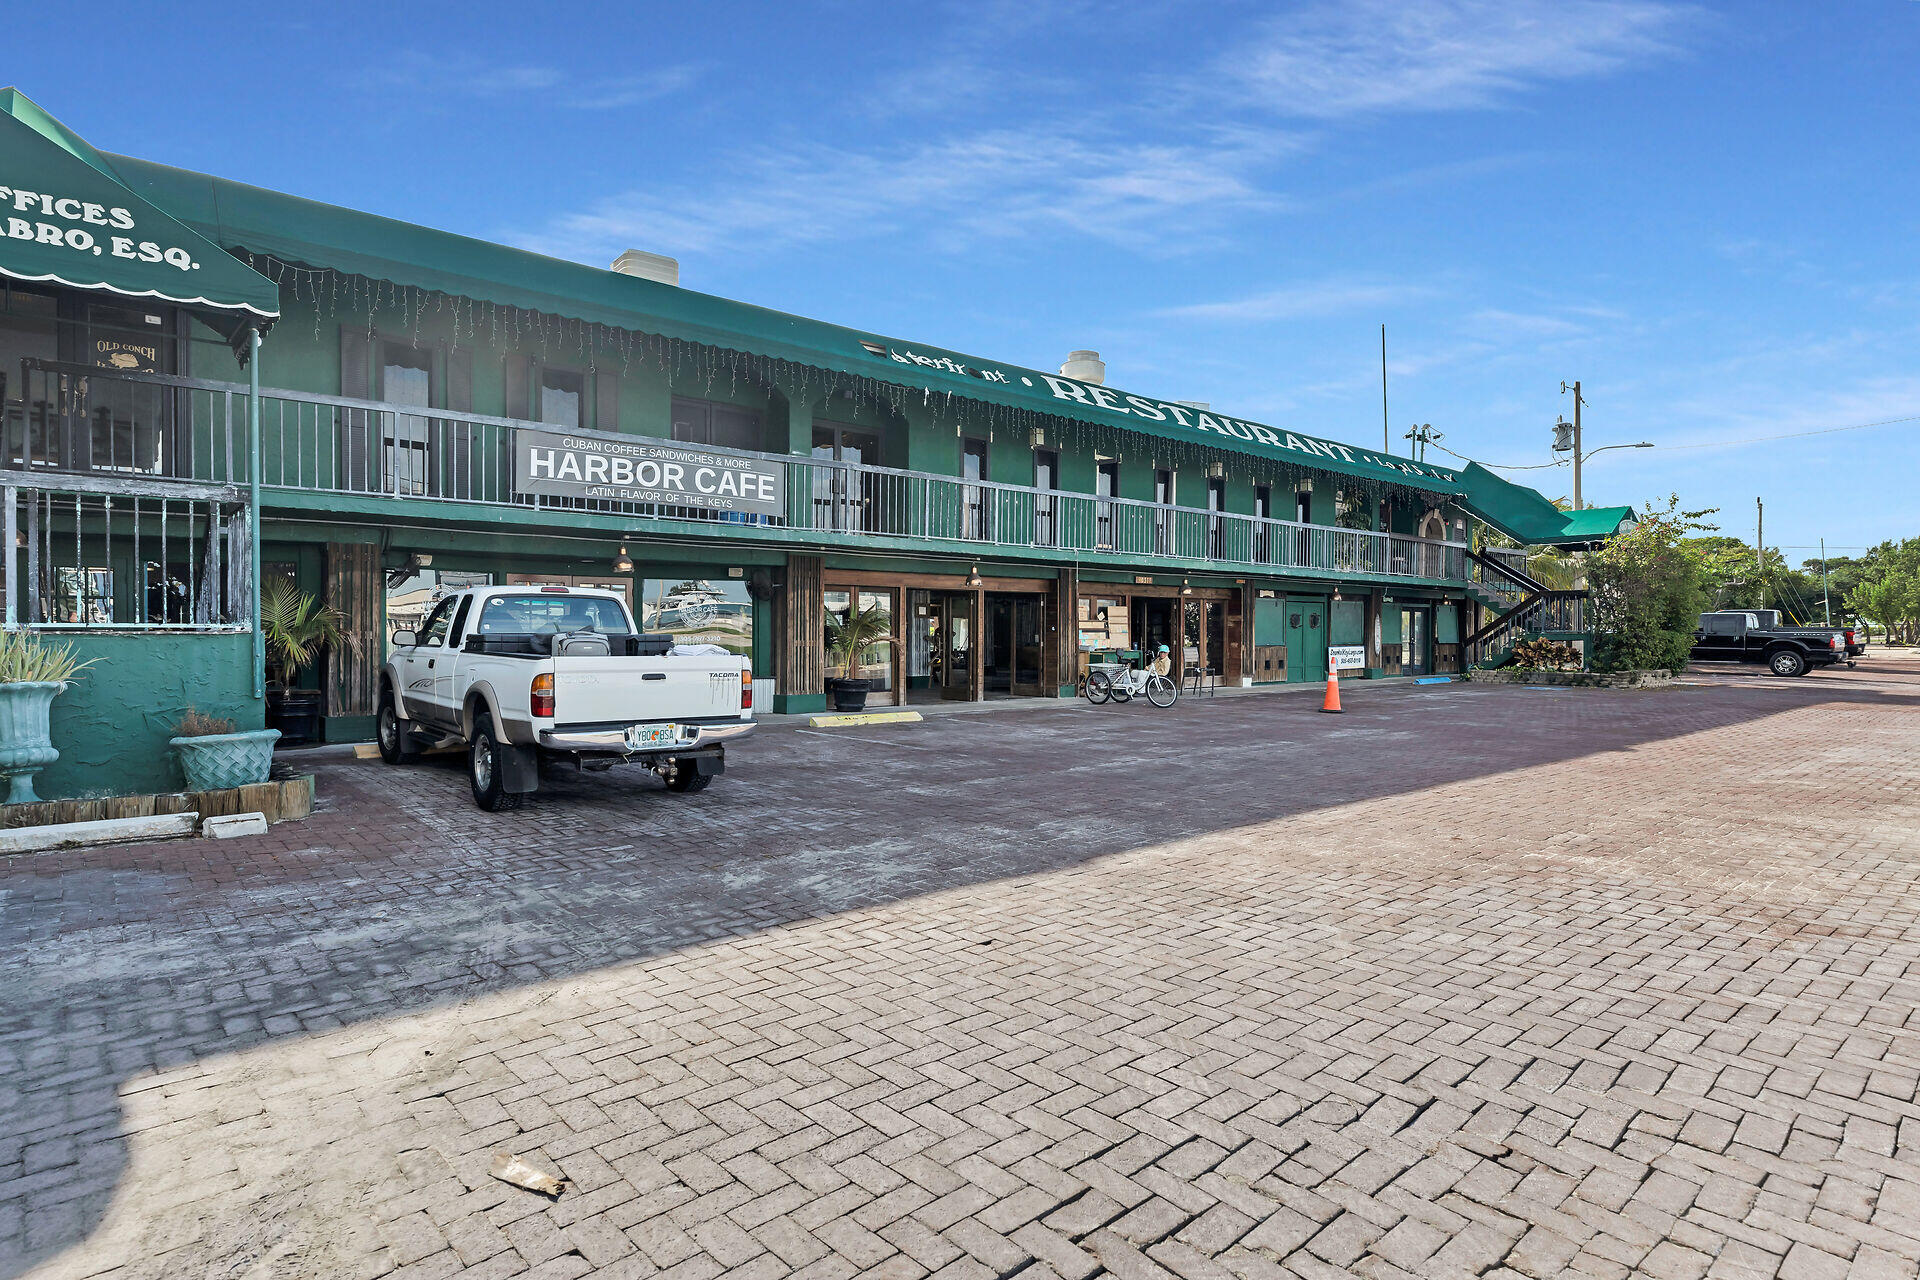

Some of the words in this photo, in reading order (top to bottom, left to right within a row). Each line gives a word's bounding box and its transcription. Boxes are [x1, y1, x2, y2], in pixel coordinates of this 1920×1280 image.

[0, 217, 102, 256] BRO,
[110, 236, 200, 271] ESQ.
[97, 340, 119, 352] OLD
[122, 343, 155, 361] CONCH
[1040, 374, 1356, 463] RESTAURANT
[530, 448, 686, 491] HARBOR
[694, 467, 776, 501] CAFE
[562, 437, 602, 452] CUBAN
[604, 443, 646, 457] COFFEE
[649, 448, 714, 465] SANDWICHES
[715, 457, 723, 466] &
[724, 458, 752, 470] MORE
[585, 486, 615, 498] LATIN
[620, 489, 661, 501] FLAVOR
[665, 493, 680, 502] OF
[684, 494, 704, 505] THE
[708, 497, 733, 509] KEYS
